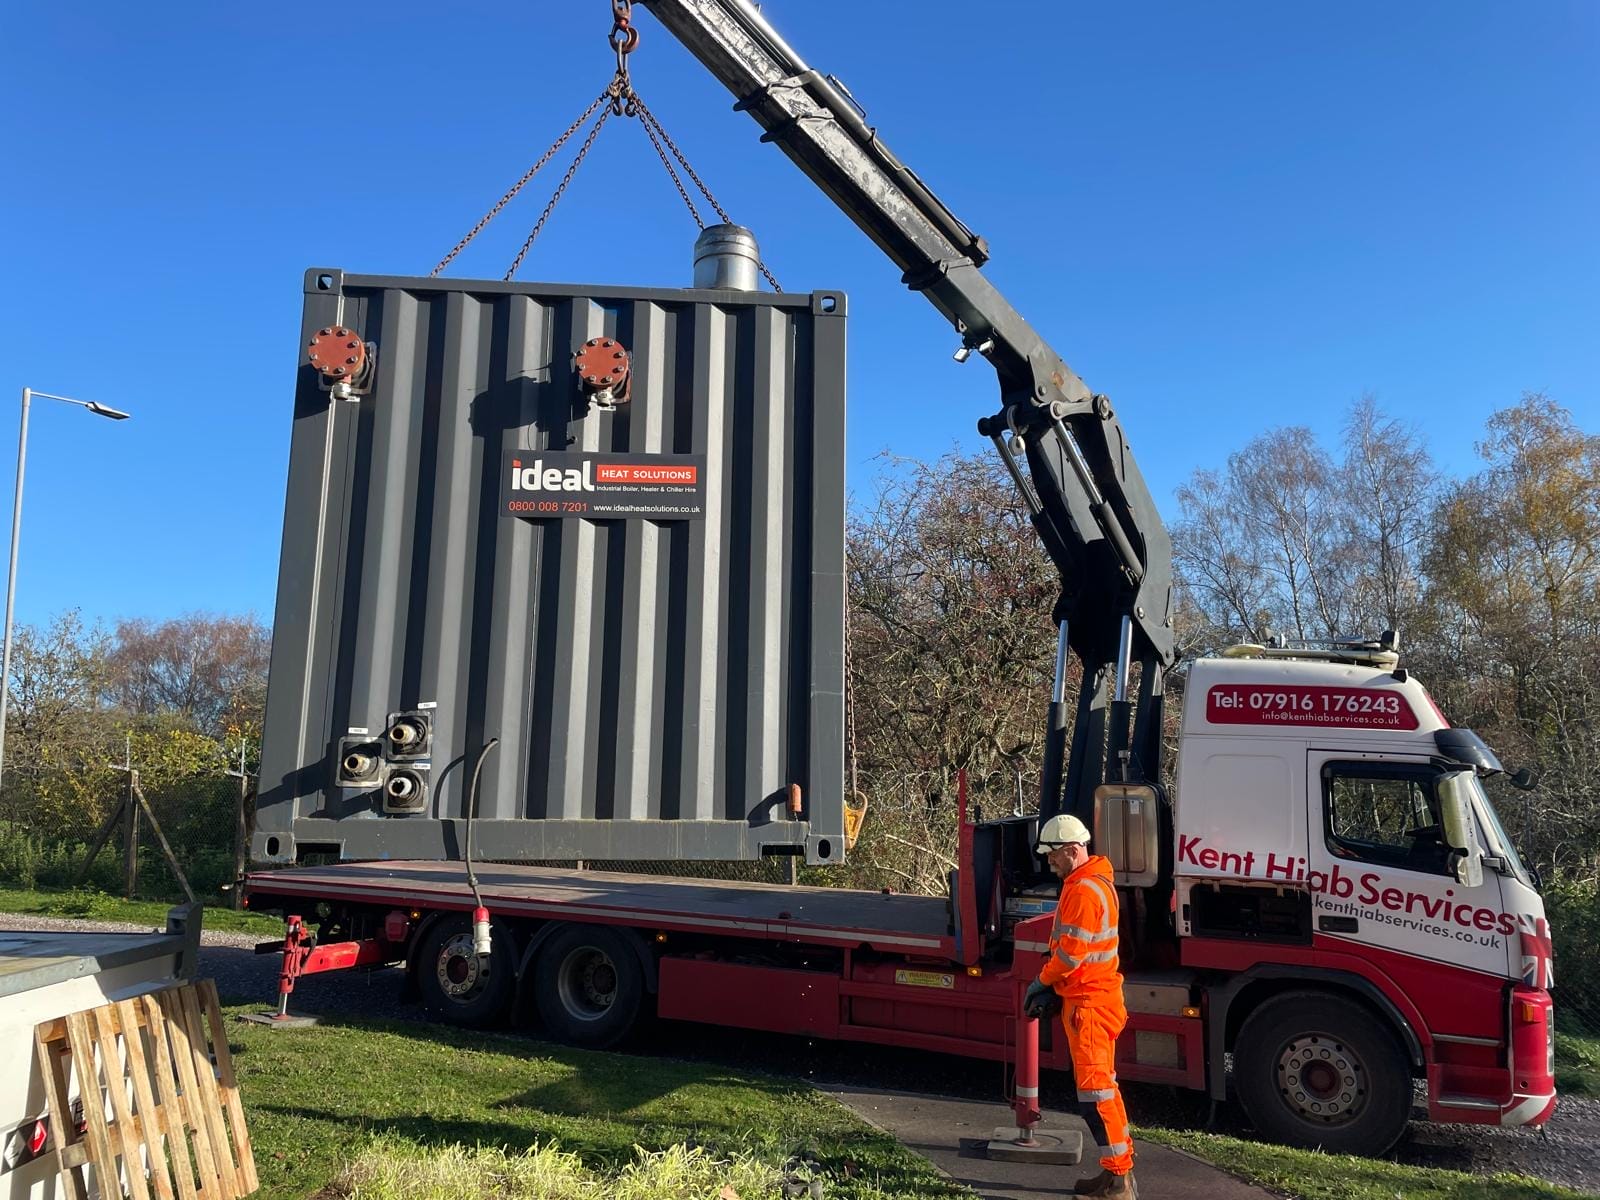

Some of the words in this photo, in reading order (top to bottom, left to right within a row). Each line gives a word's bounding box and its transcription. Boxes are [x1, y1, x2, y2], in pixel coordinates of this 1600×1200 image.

[512, 459, 594, 492] ideal
[601, 470, 629, 478] HEAT
[633, 470, 692, 480] SOLUTIONS
[508, 501, 536, 512] 0800
[538, 502, 559, 512] 008
[562, 502, 588, 512] 7201
[593, 504, 700, 513] www.idealheatsolutions.co.uk
[1212, 691, 1244, 708] Tel:
[1250, 693, 1314, 710] 07916
[1321, 695, 1400, 713] 176243
[1262, 711, 1400, 725] info@kenthiabservices.co.uk
[1178, 834, 1255, 877] Kent
[1265, 852, 1354, 899] Hiab
[1357, 873, 1516, 936] Services
